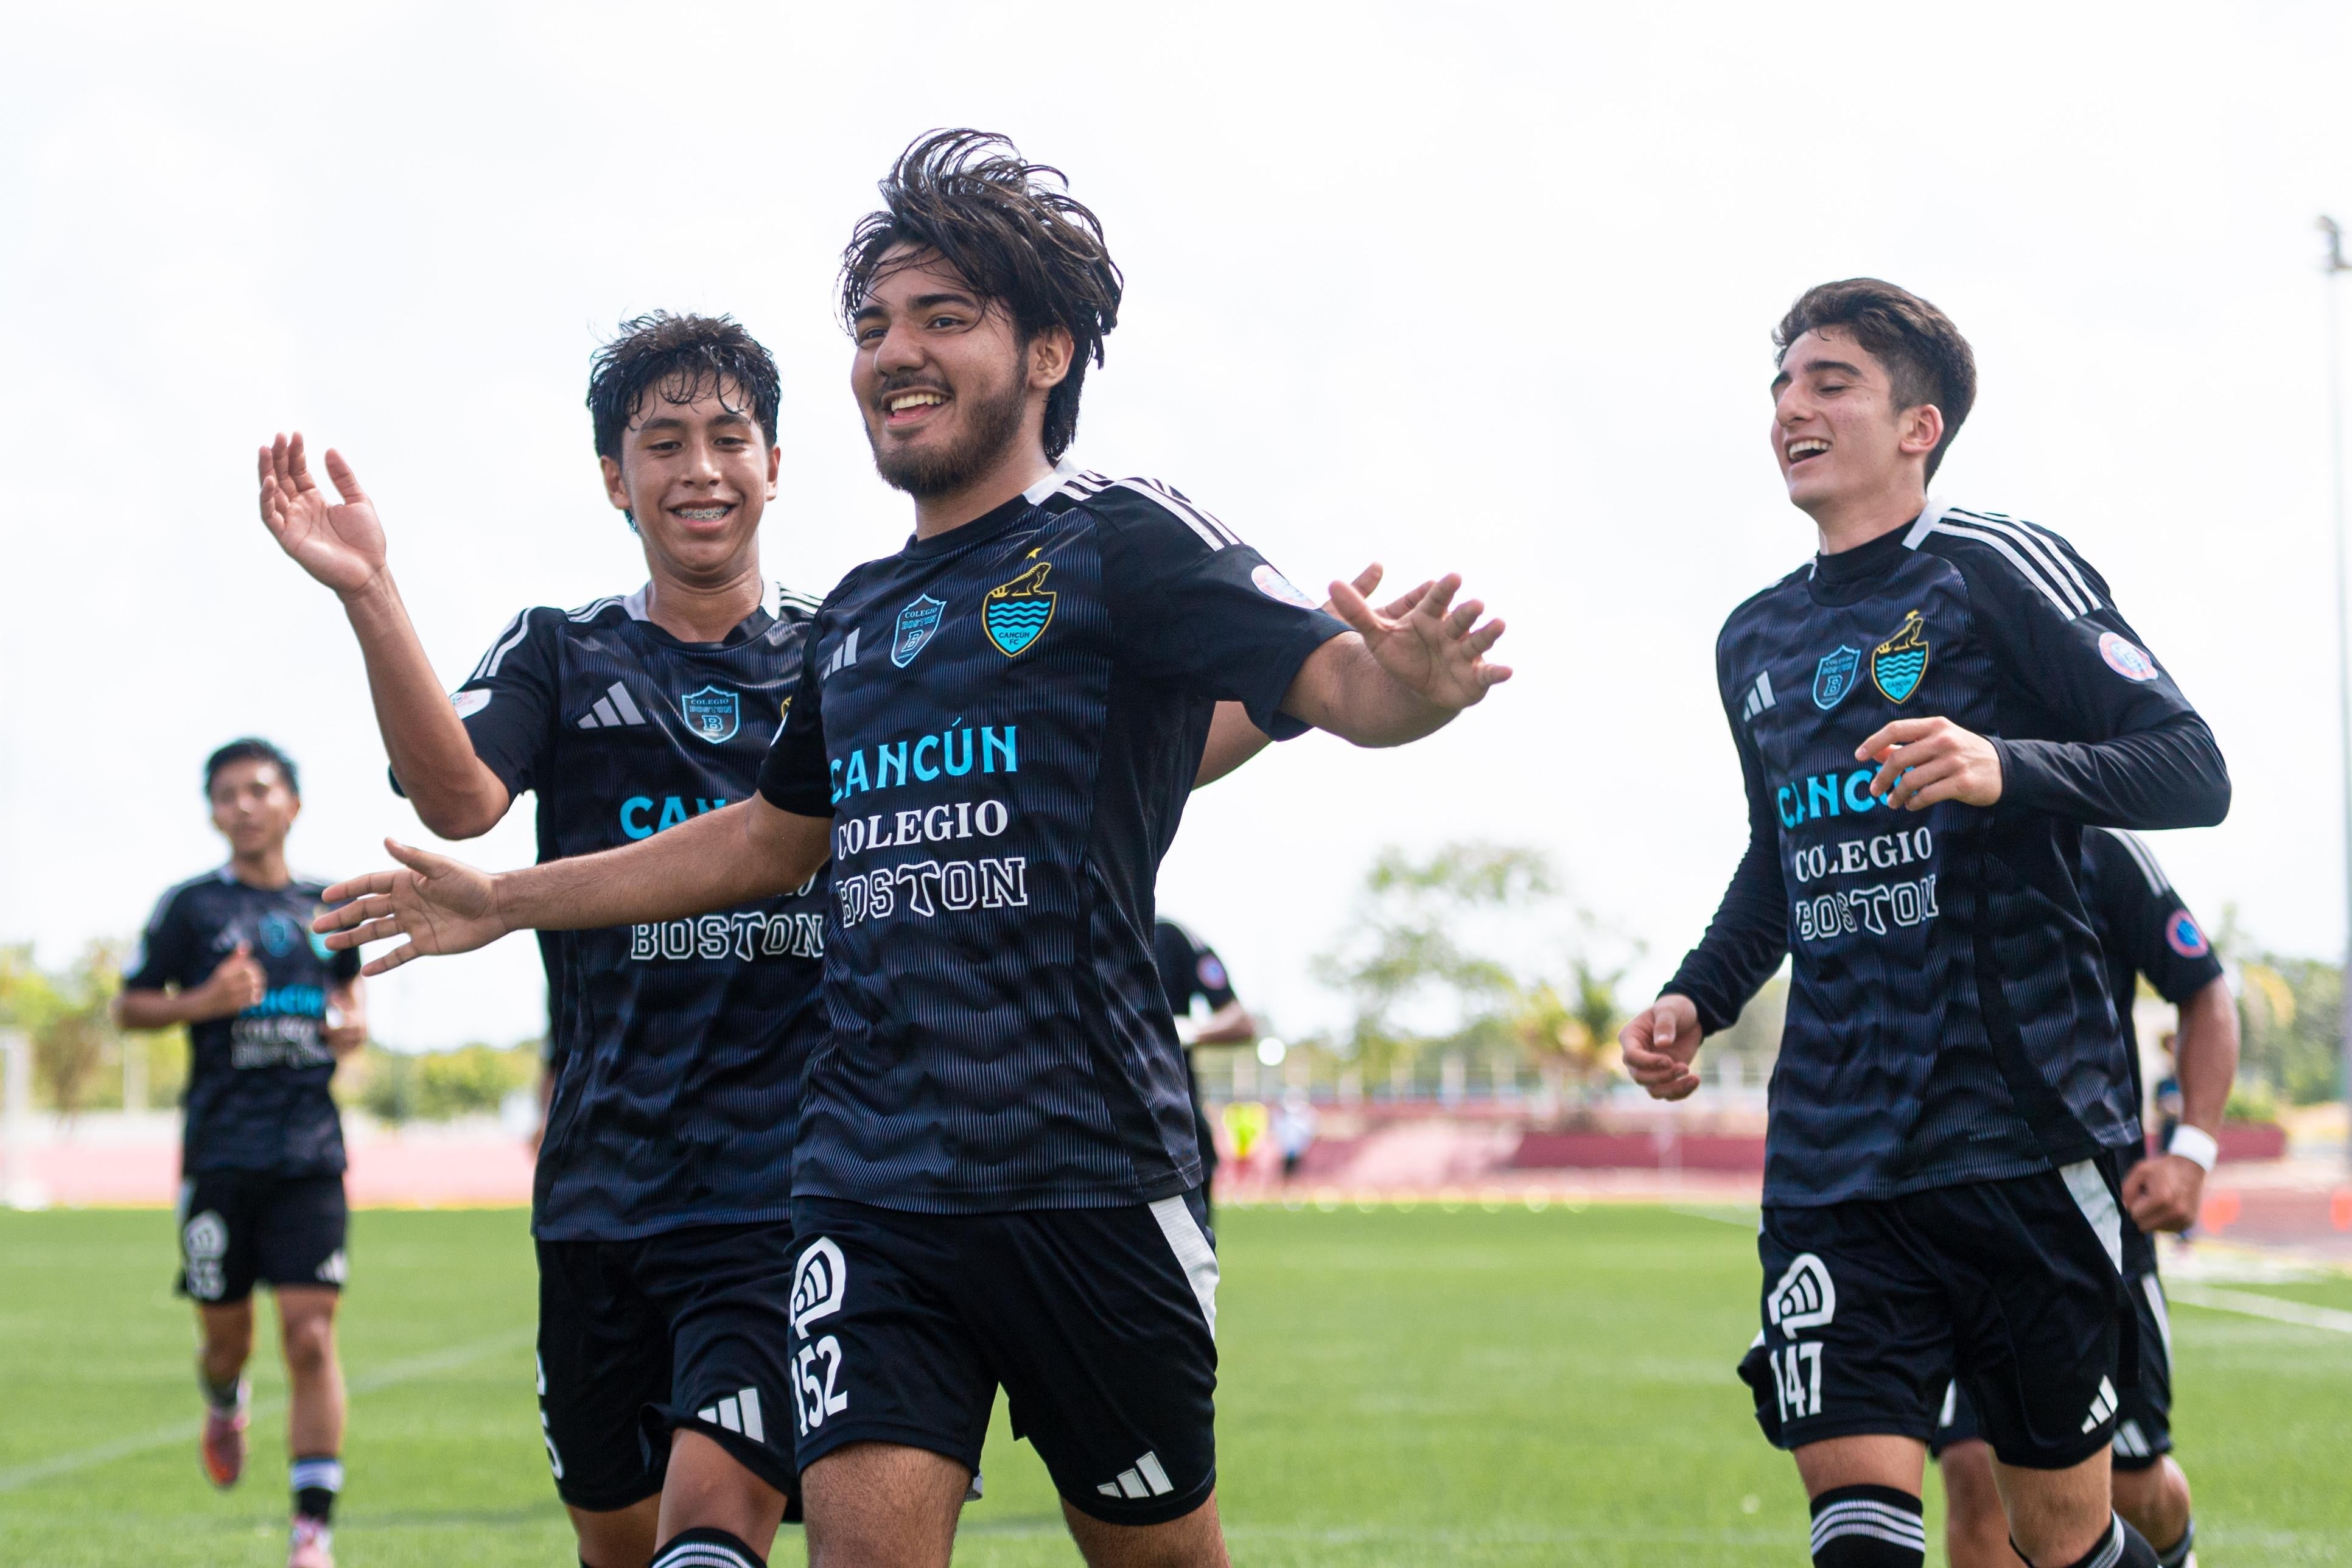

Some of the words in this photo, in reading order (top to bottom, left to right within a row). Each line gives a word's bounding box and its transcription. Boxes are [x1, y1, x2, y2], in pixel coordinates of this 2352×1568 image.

[901, 629, 924, 653] B
[905, 607, 937, 618] COLEGIO
[1824, 674, 1843, 696] B
[701, 715, 723, 731] B
[830, 716, 1017, 804] CANCÚN
[838, 800, 1008, 860] COLEGIO
[1796, 826, 1933, 882] COLEGIO
[836, 857, 1028, 928] BOSTON
[1796, 874, 1939, 941] BOSTON
[631, 911, 825, 962] BOSTON
[791, 1335, 847, 1437] 152
[1769, 1341, 1824, 1423] 147
